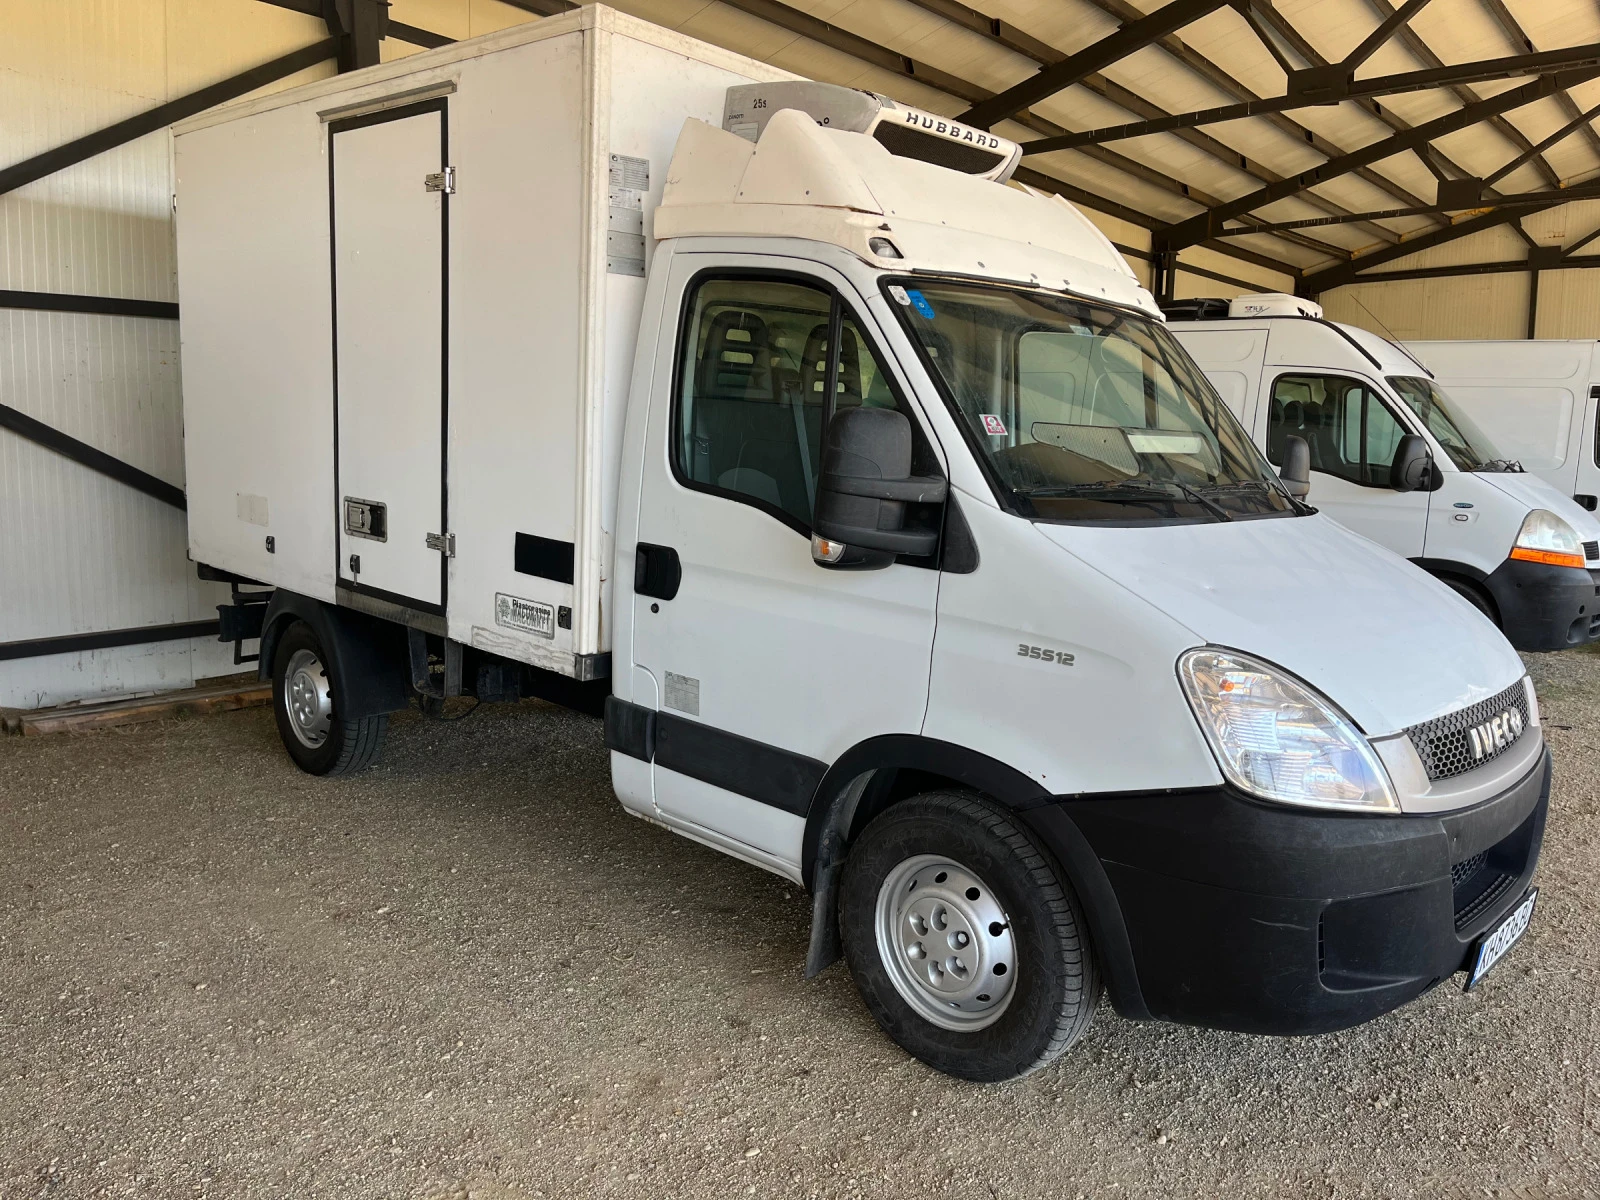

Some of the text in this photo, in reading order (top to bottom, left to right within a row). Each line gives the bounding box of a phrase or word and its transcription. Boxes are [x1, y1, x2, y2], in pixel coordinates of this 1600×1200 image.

[906, 111, 999, 149] HUBBARD
[1017, 643, 1075, 667] 35S12
[1467, 706, 1522, 759] IVECO
